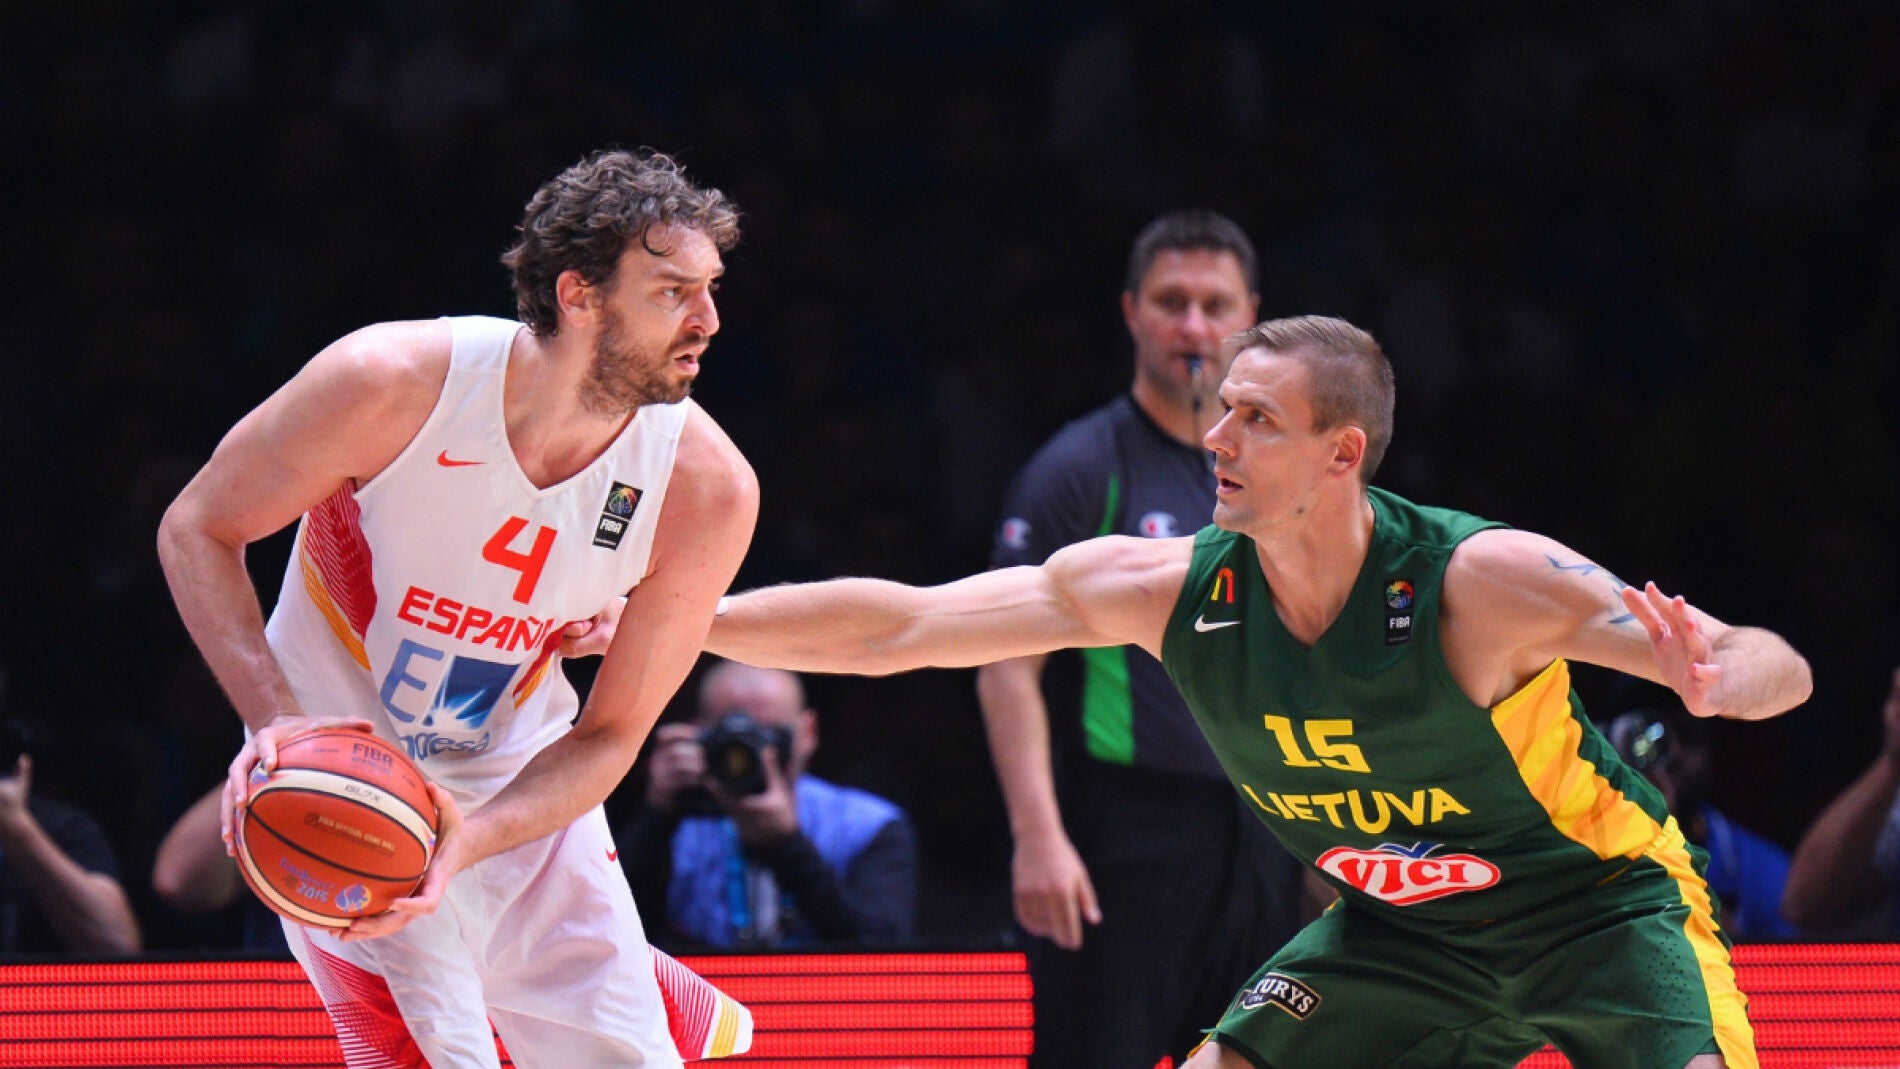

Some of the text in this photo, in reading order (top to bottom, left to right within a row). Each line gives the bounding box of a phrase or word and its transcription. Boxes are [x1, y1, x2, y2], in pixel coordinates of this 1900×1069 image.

[482, 516, 558, 605] 4
[397, 586, 555, 652] ESPAÑ
[1390, 616, 1410, 629] FIBA
[353, 743, 393, 769] FIBA
[1264, 714, 1372, 774] 15
[1241, 783, 1472, 834] LIETUVA
[297, 882, 329, 903] 2015
